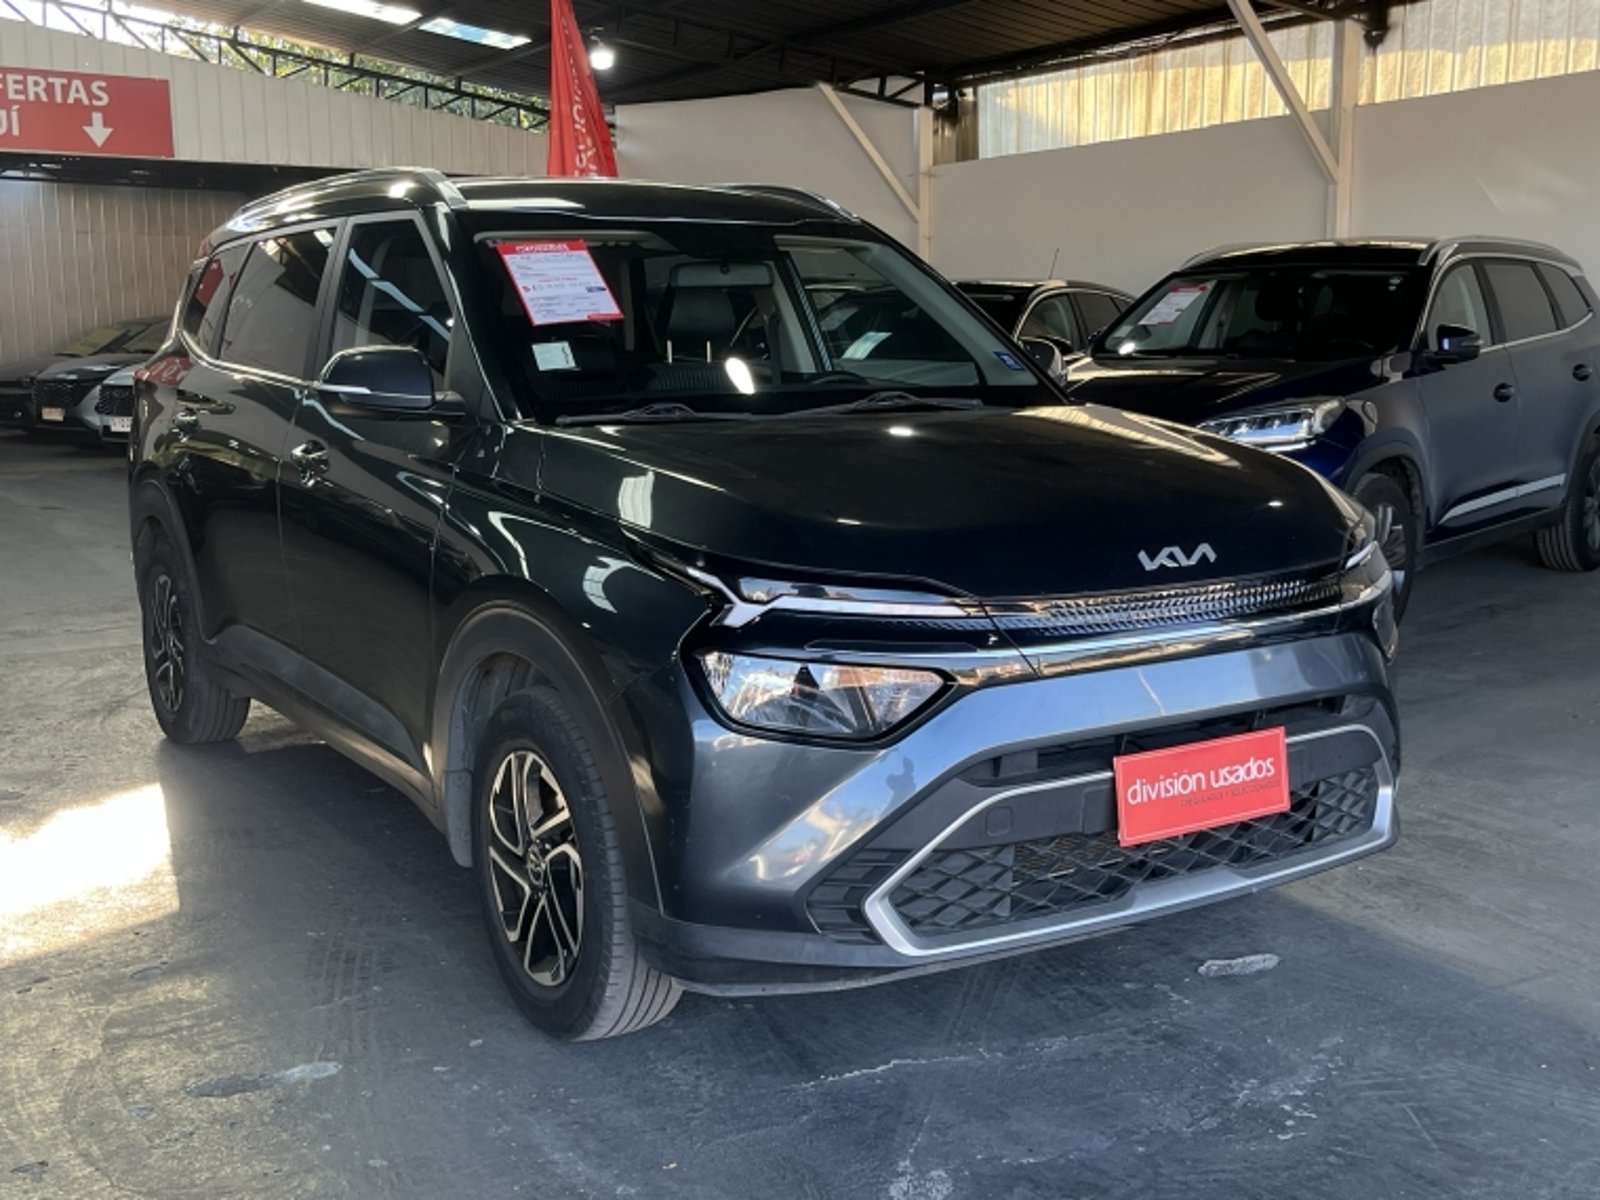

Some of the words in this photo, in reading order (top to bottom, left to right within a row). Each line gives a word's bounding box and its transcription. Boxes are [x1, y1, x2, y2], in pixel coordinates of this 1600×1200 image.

[0, 73, 109, 106] ERTAS
[1127, 769, 1205, 805] división
[1210, 757, 1275, 788] usados
